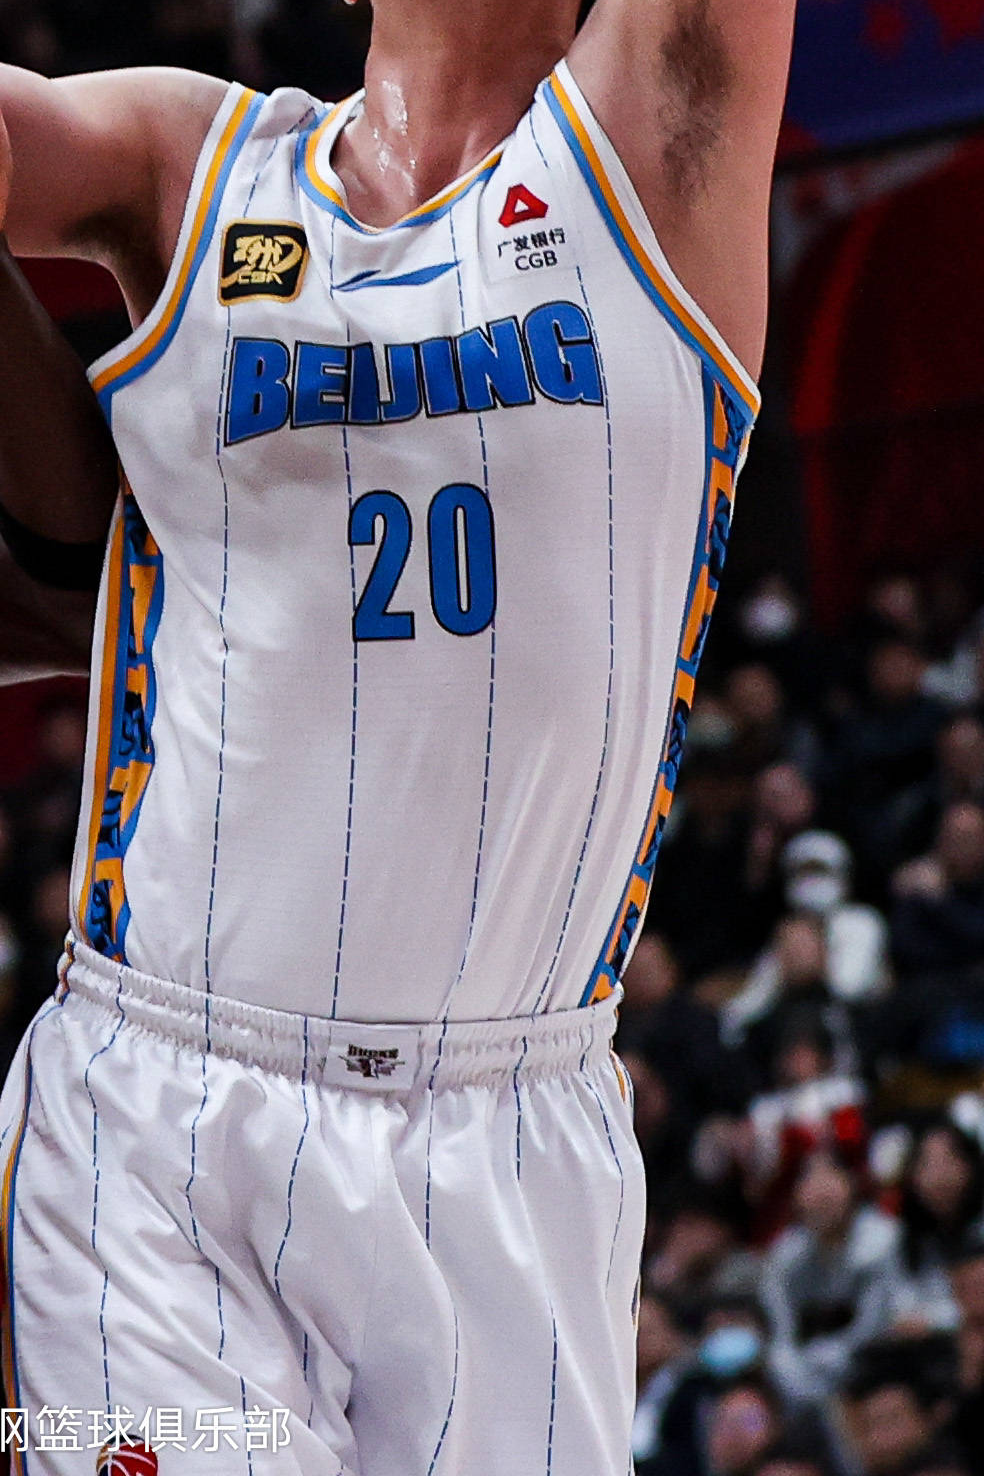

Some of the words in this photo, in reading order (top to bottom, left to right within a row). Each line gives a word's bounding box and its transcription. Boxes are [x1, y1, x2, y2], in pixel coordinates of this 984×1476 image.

[497, 228, 565, 259] 广发银行
[515, 250, 558, 271] CGB
[224, 301, 604, 446] BEIJING
[347, 482, 497, 640] 20
